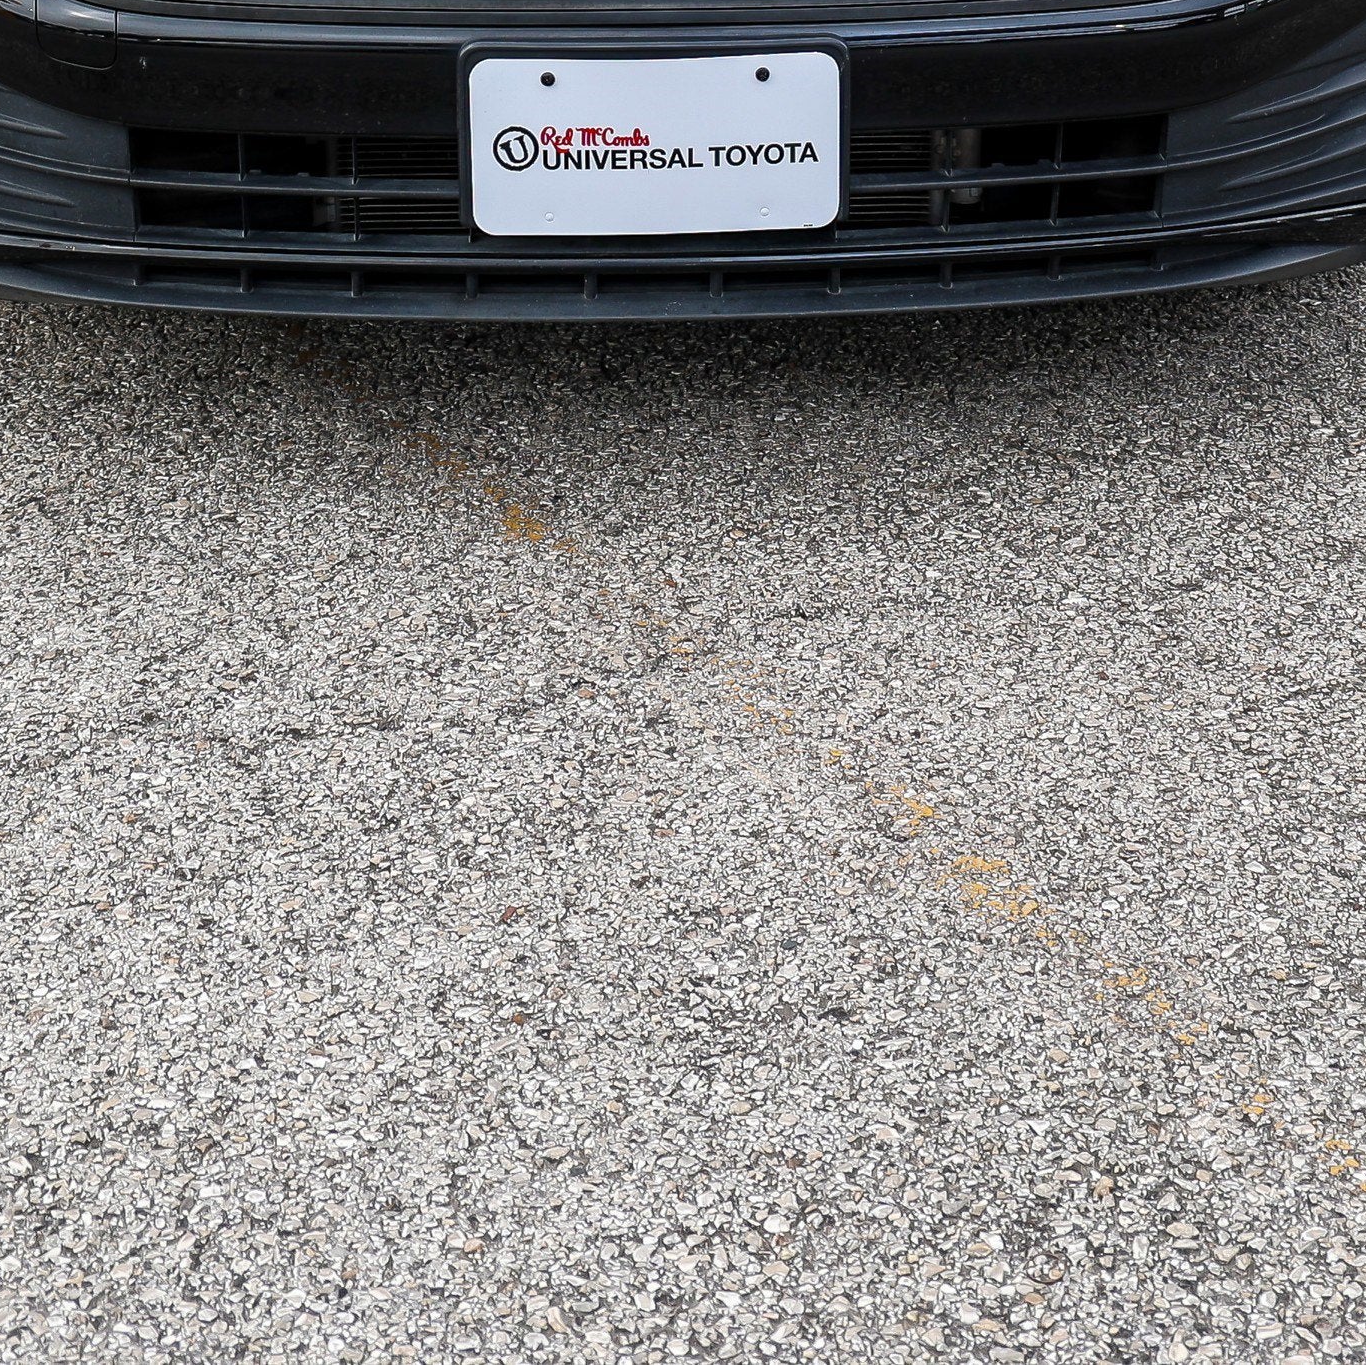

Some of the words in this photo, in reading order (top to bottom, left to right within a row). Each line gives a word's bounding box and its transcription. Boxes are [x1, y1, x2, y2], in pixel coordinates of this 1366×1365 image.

[540, 126, 574, 150] Red
[575, 126, 651, 147] McCombs
[542, 148, 703, 171] UNIVERSAL
[708, 142, 820, 167] TOYOTA
